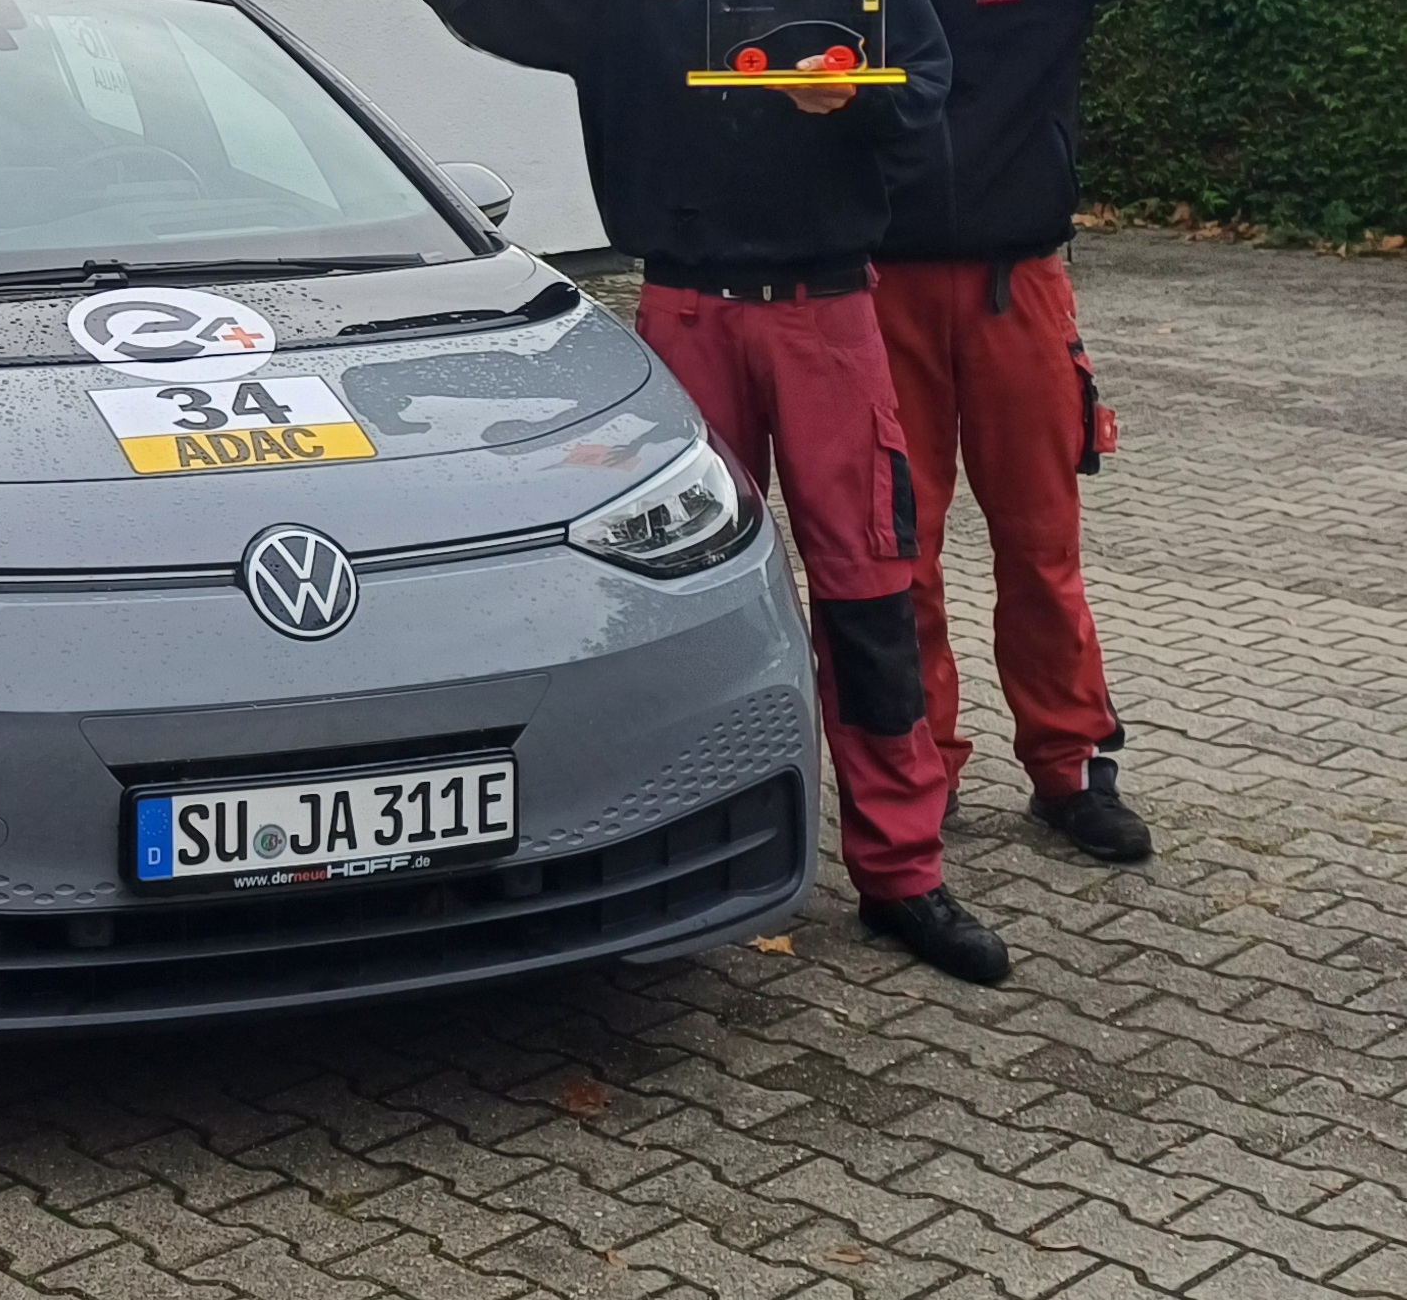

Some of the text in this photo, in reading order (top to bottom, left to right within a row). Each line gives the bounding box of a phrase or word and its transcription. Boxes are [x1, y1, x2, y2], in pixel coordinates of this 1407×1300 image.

[157, 382, 292, 431] 34
[175, 428, 325, 468] ADAC
[147, 772, 508, 867] D SU JA 311E
